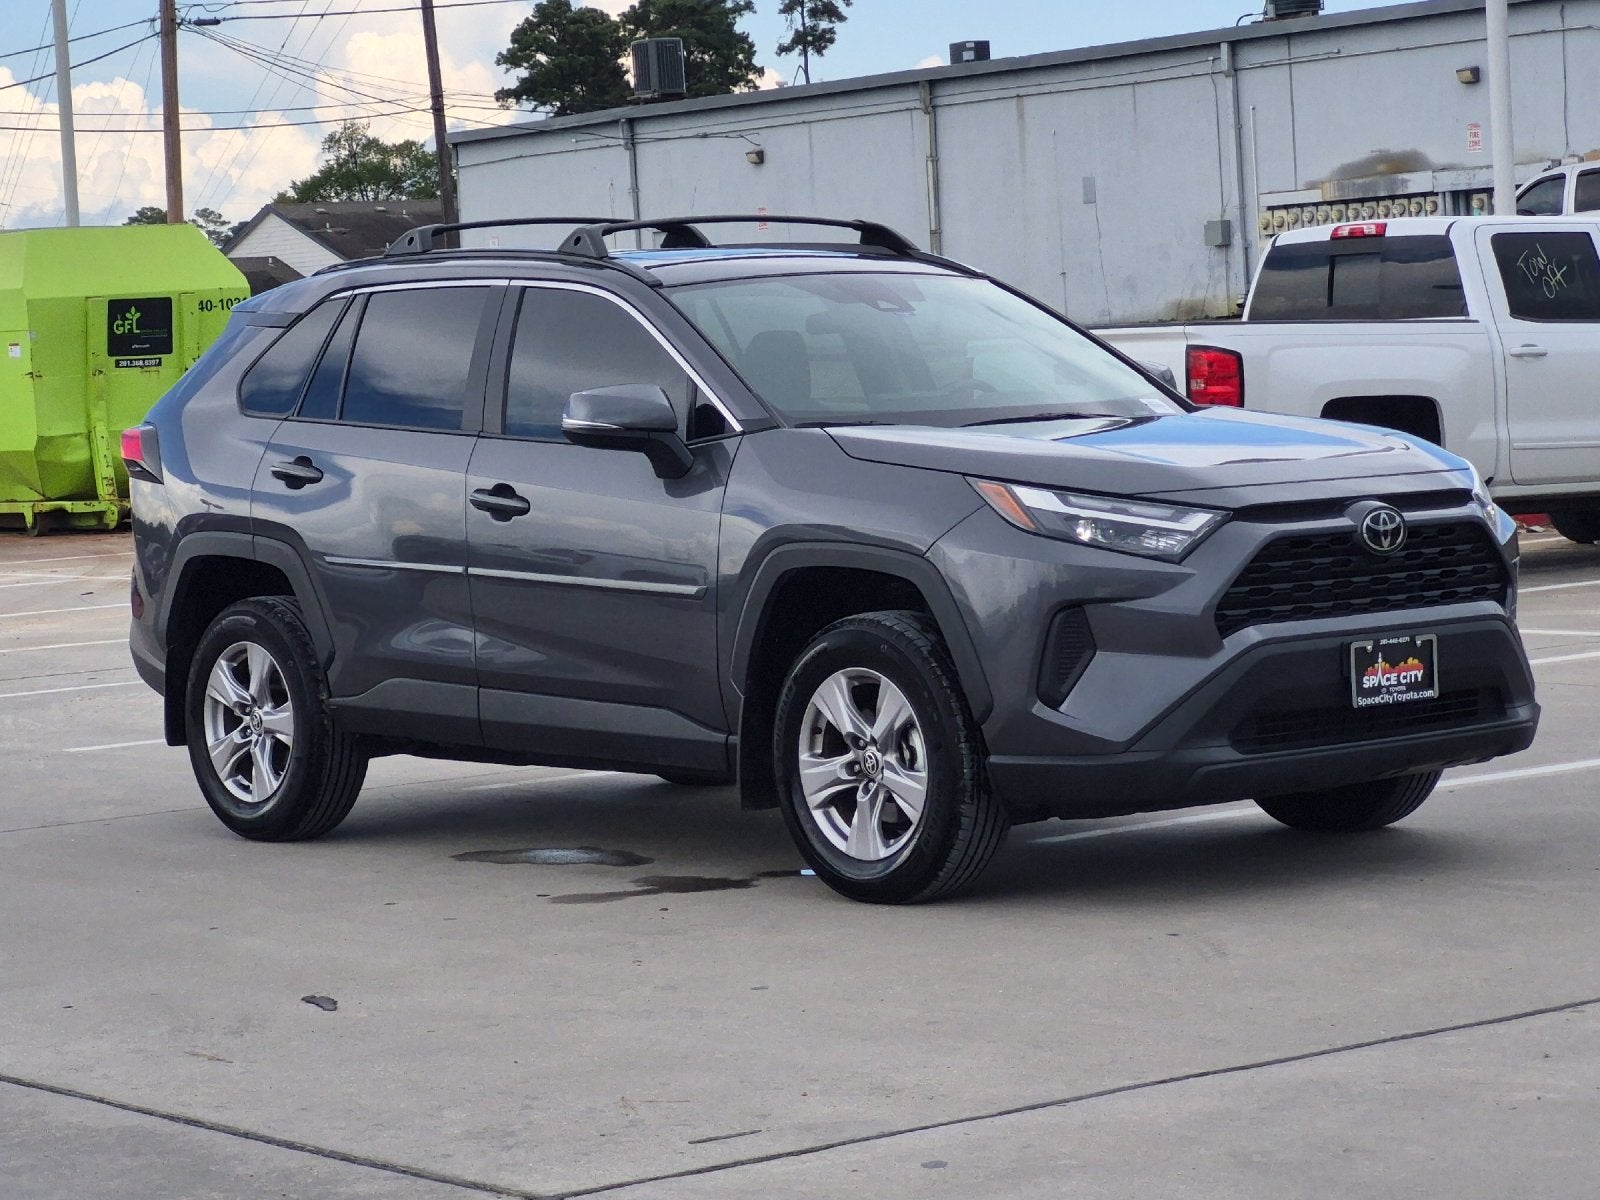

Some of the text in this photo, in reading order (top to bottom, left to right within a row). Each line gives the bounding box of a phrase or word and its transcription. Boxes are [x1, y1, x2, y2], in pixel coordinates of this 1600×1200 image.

[113, 314, 140, 335] GFL
[1363, 670, 1424, 688] SPACE CITY
[1357, 690, 1434, 706] SpaceCityToyota.com
